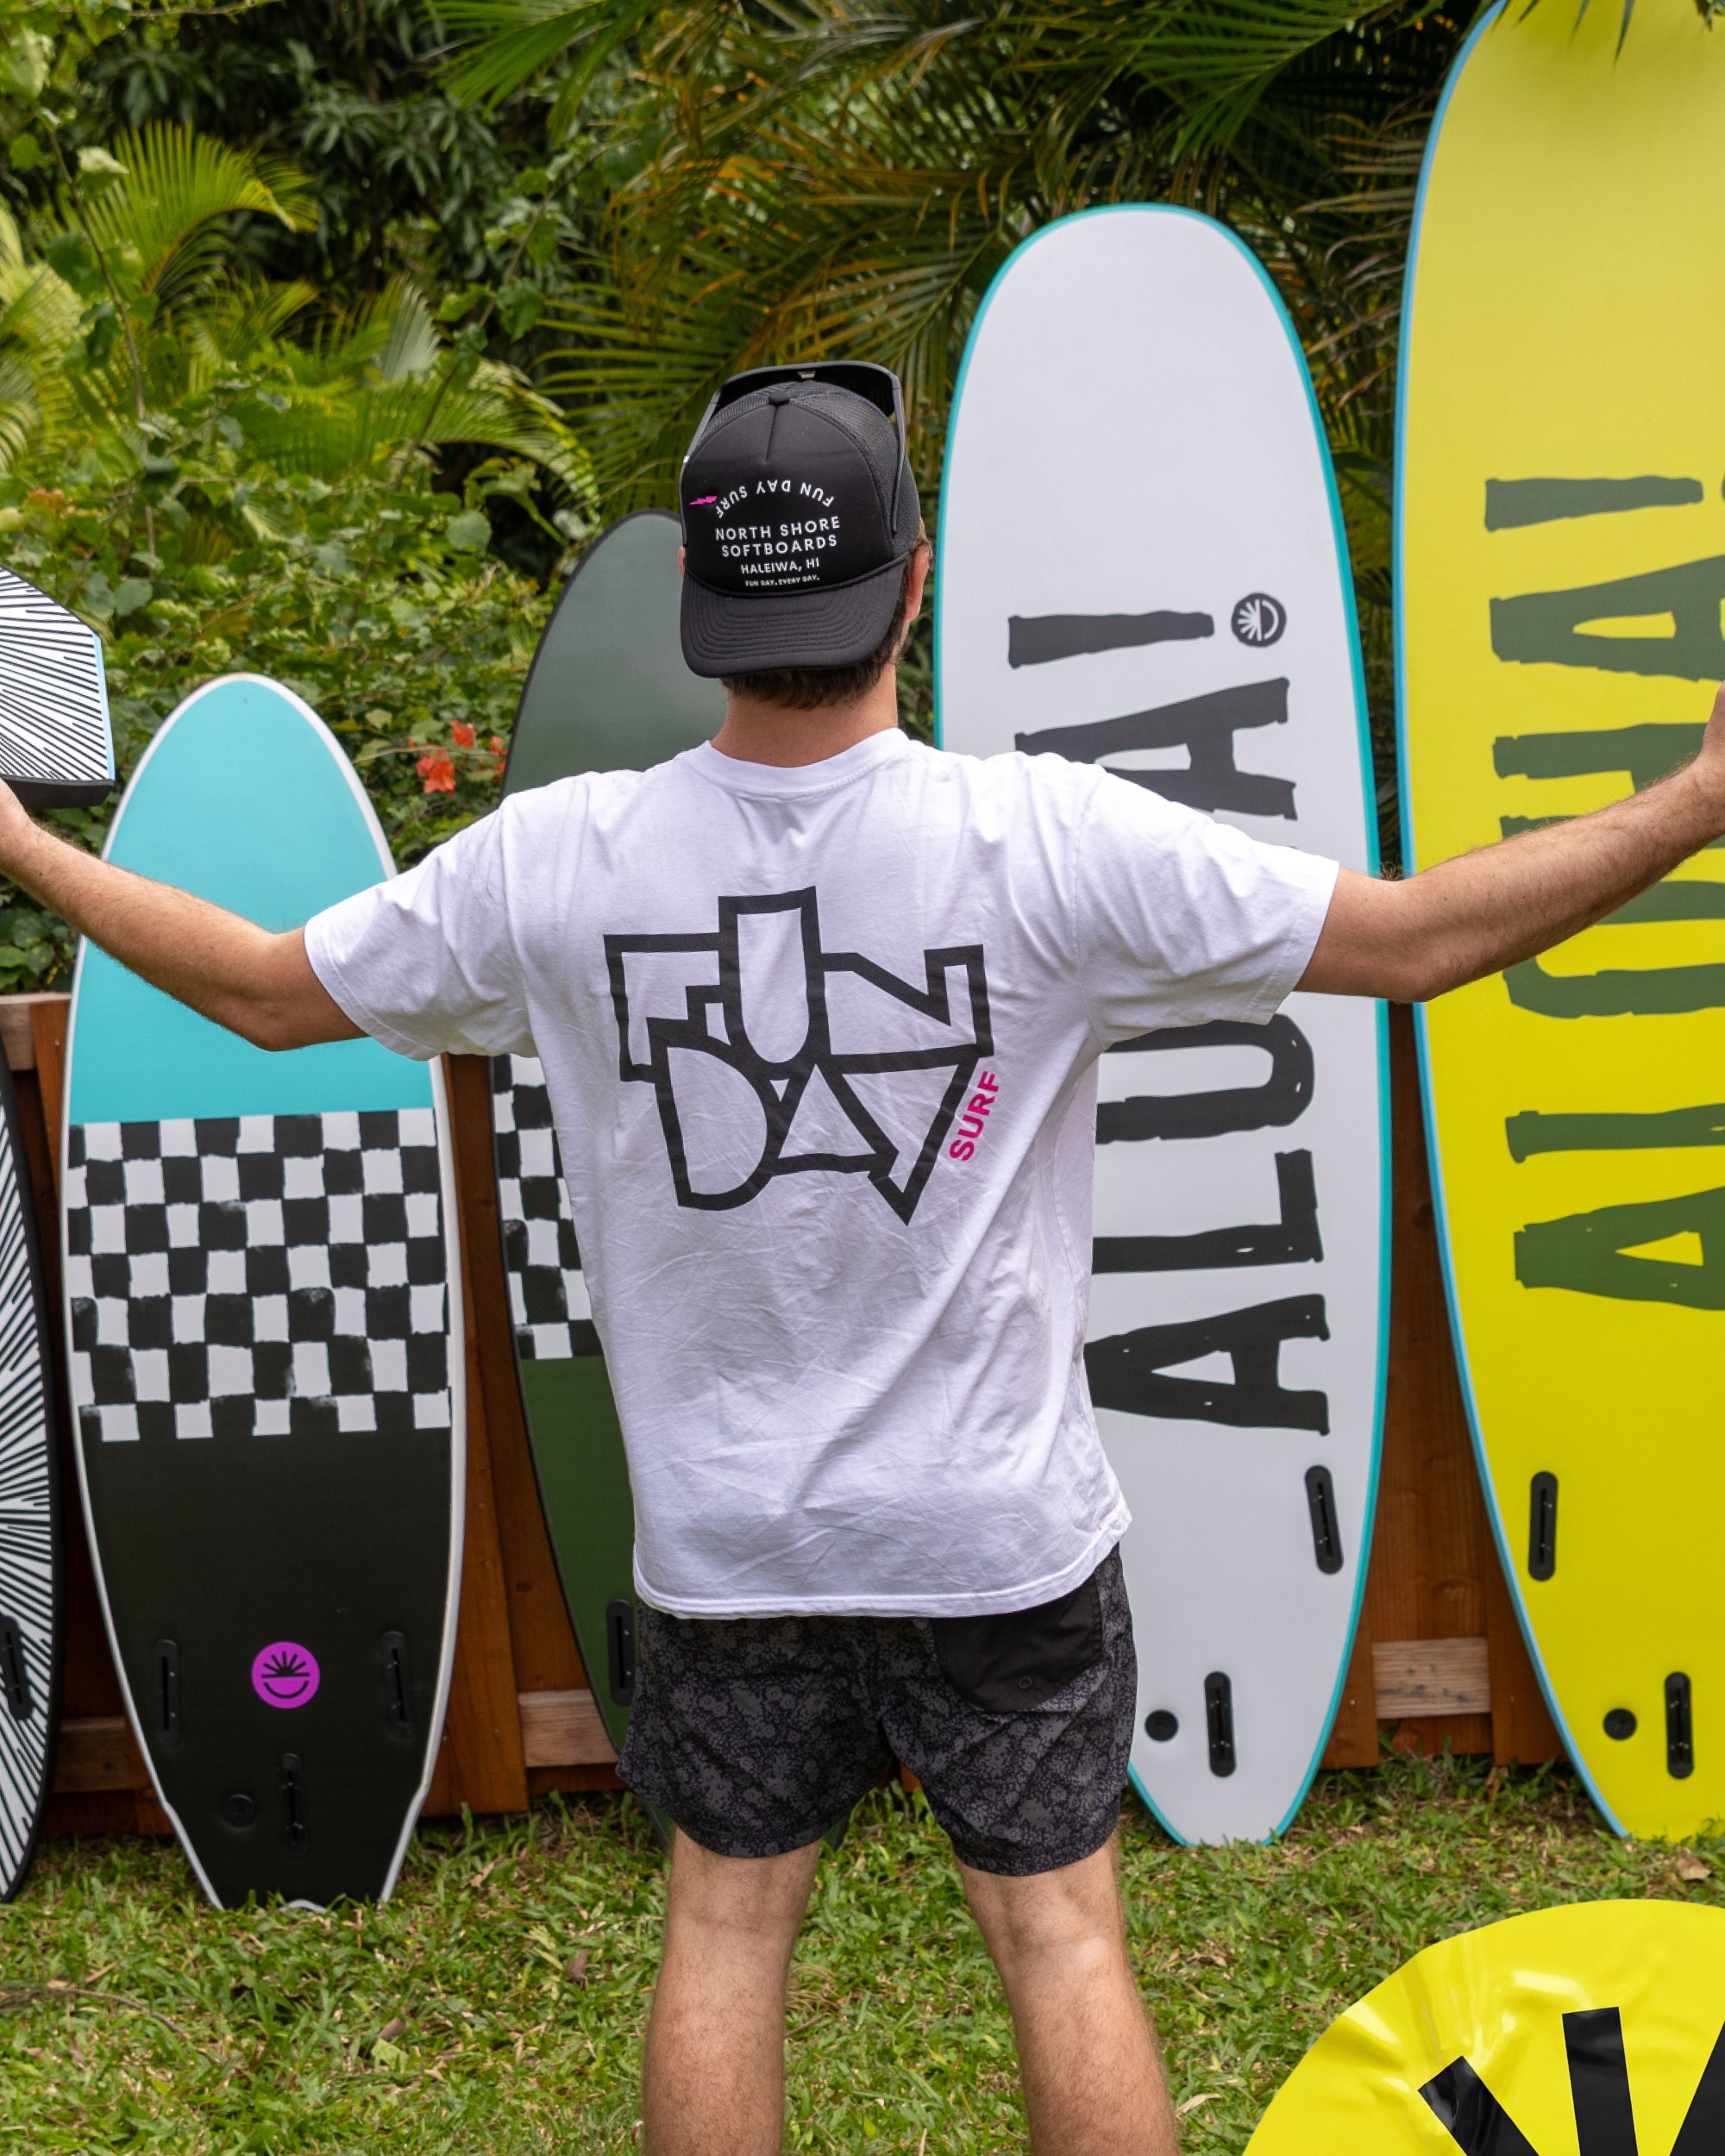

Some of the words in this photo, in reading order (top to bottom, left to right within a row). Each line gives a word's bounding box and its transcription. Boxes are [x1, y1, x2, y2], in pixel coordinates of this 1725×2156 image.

[756, 479, 791, 494] DAY
[800, 481, 835, 507] FUN
[715, 486, 748, 519] SURF
[715, 525, 772, 541] NORTH
[780, 516, 840, 536] SHORE
[721, 534, 837, 557] SOFTBOARDS
[741, 560, 802, 574] HALEIWA,
[806, 556, 820, 569] HI
[778, 577, 800, 586] EVERY
[604, 886, 994, 1081] FUN
[1007, 592, 1330, 1435] ALOA!
[646, 1018, 994, 1226] DAY
[950, 1070, 1000, 1162] SURF
